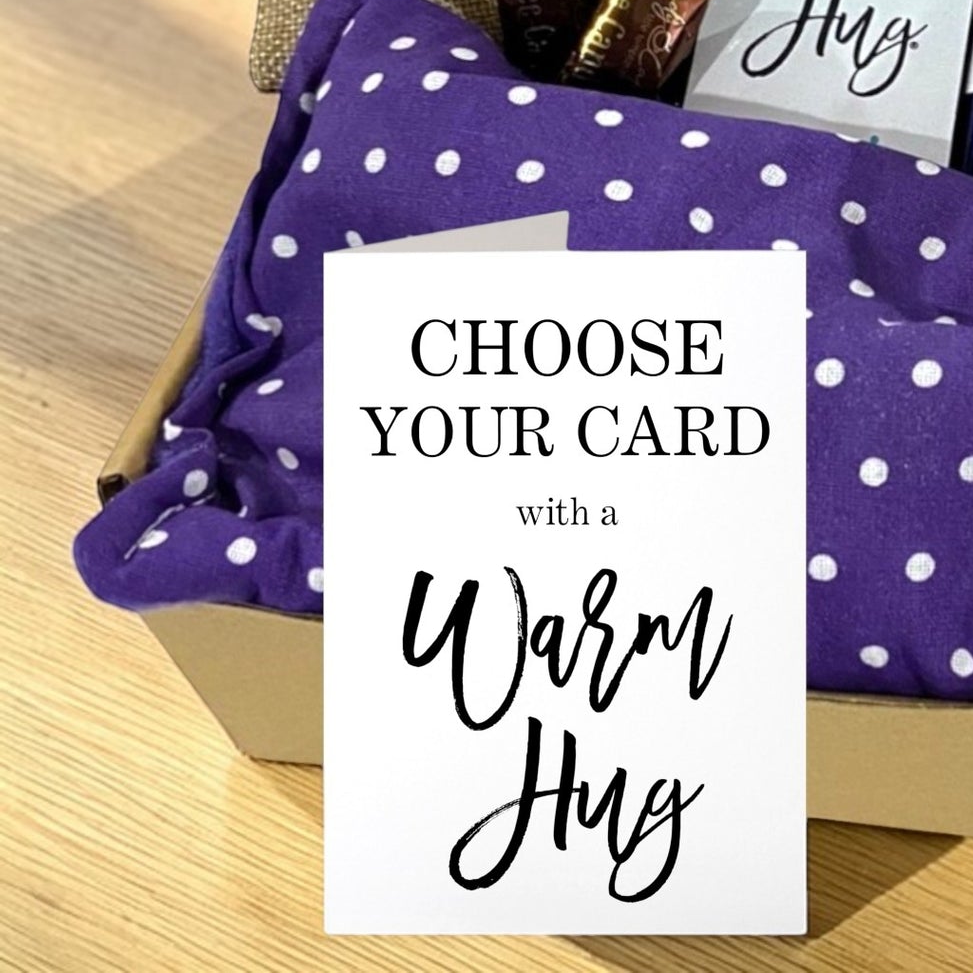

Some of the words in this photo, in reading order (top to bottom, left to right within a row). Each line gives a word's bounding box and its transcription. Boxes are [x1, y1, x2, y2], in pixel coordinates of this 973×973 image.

[410, 318, 724, 377] CHOOSE
[360, 405, 554, 458] YOUR
[577, 405, 770, 458] CARD
[516, 497, 590, 526] with
[600, 506, 619, 526] a
[402, 566, 734, 731] Warm
[448, 716, 705, 903] Hug
